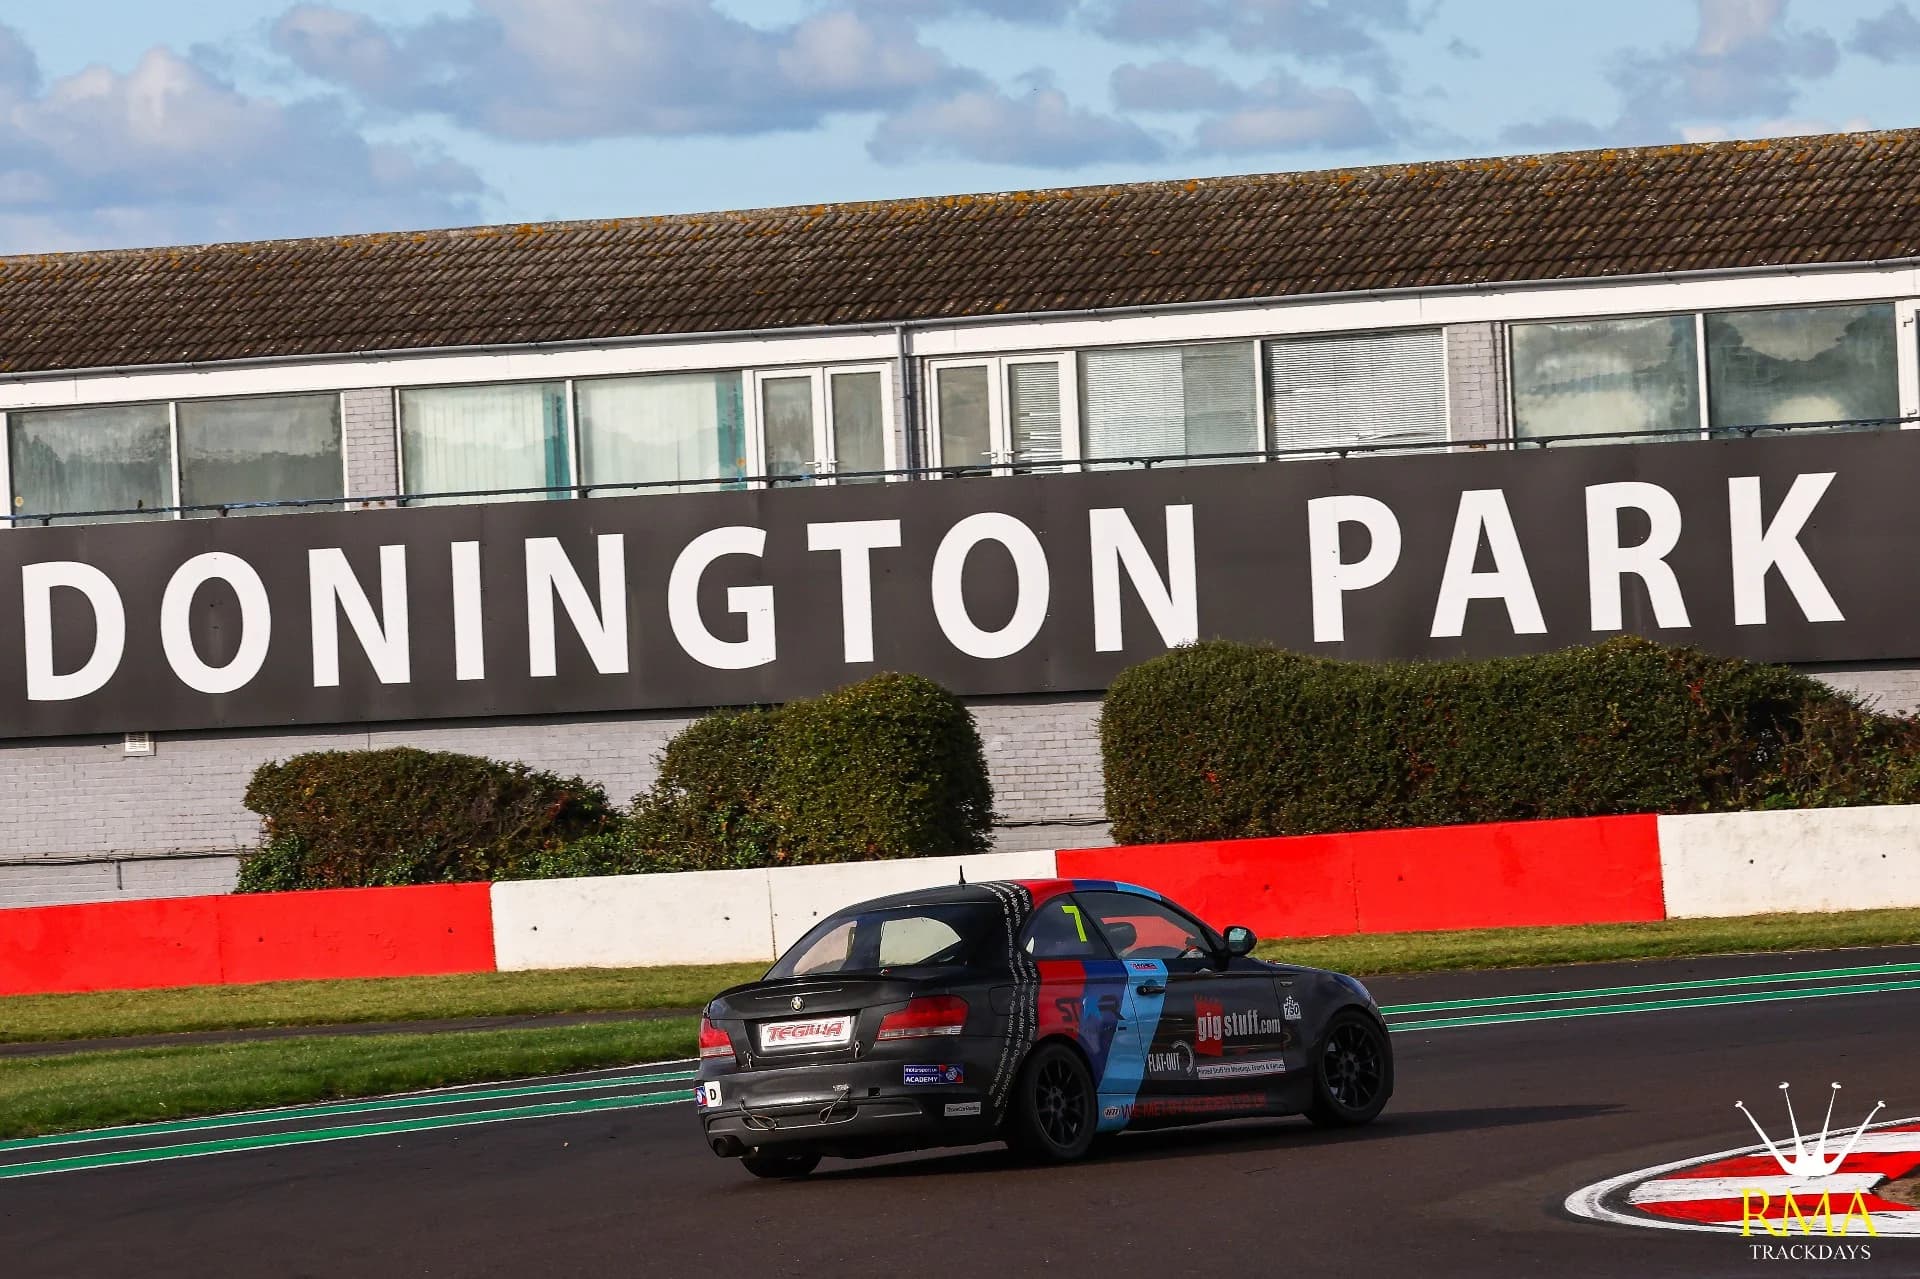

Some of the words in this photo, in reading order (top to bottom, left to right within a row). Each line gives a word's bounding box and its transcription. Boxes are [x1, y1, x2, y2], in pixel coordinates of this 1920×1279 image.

[22, 504, 1199, 701] DONINGTON
[1308, 472, 1846, 643] PARK
[1061, 905, 1087, 943] 7
[1284, 1004, 1299, 1016] 750
[1147, 1052, 1180, 1073] FLAT-OUT
[710, 1088, 717, 1101] D
